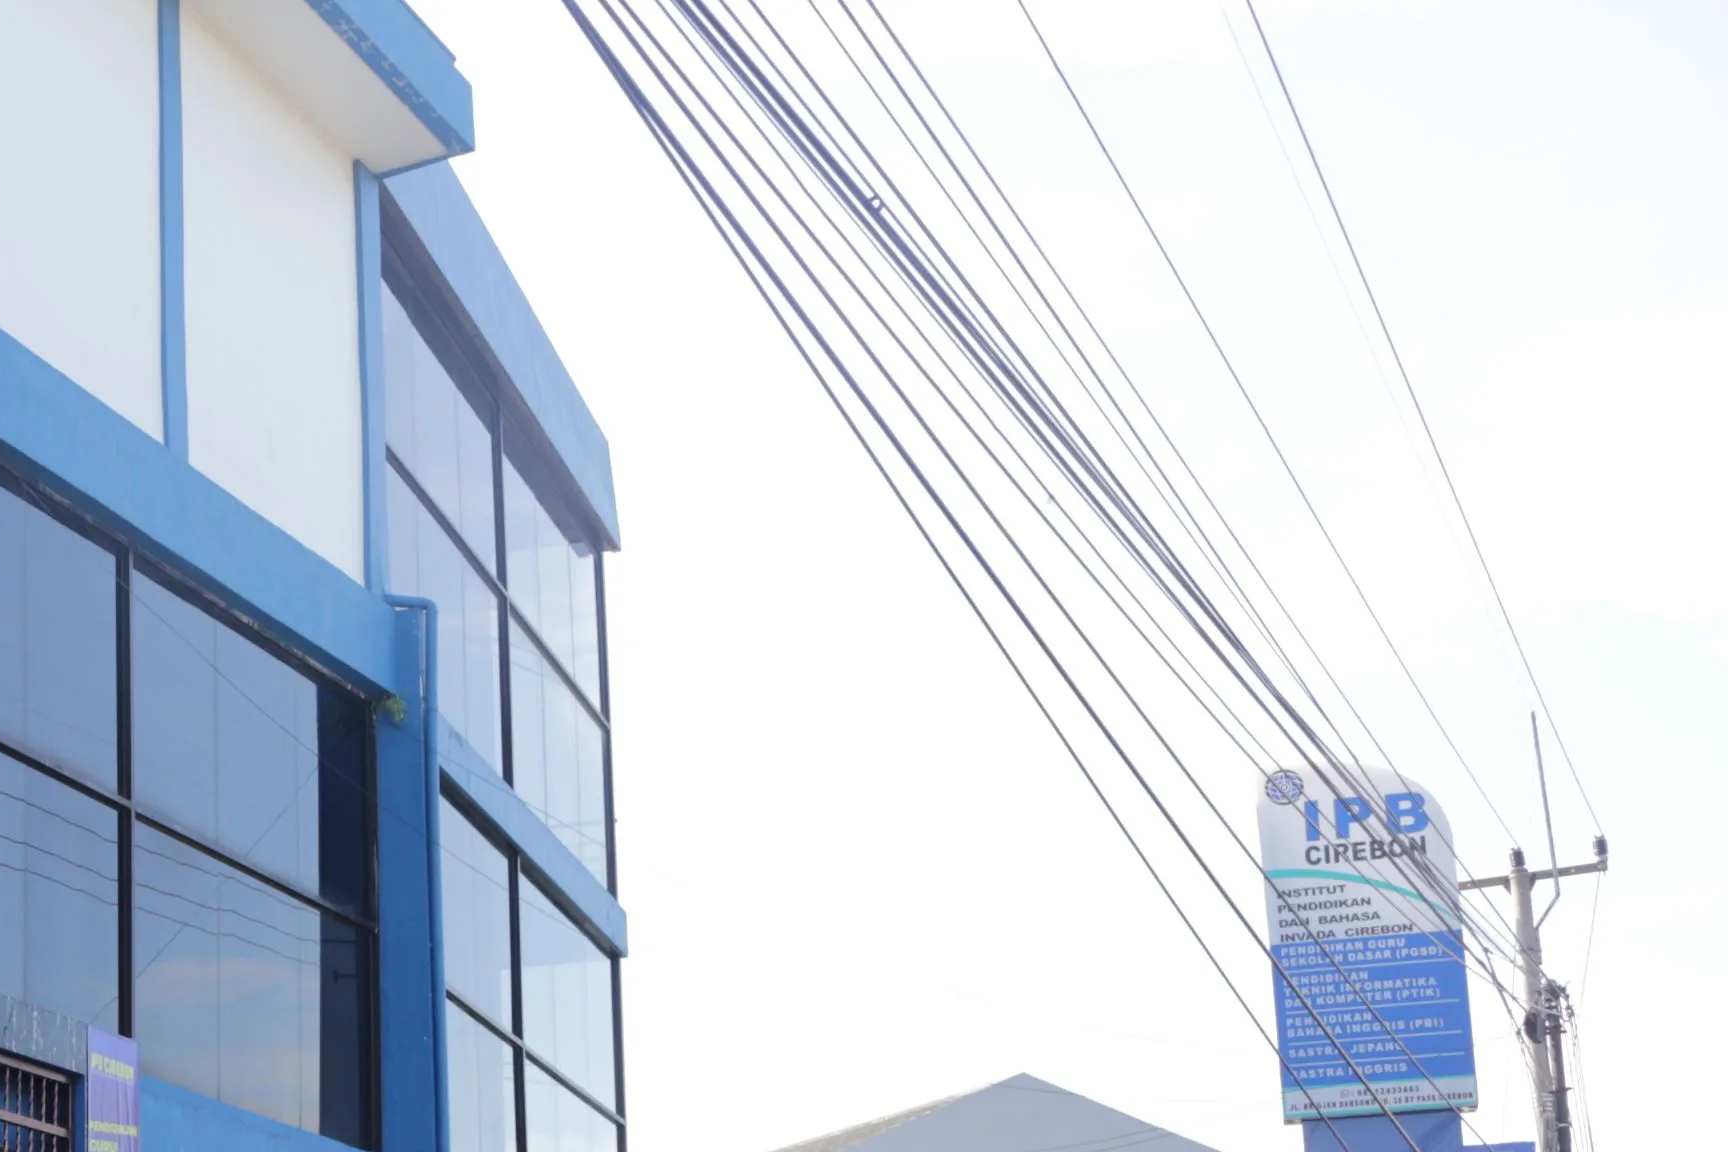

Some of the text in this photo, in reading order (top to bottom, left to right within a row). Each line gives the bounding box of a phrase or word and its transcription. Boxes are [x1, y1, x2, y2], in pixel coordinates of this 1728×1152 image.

[1304, 792, 1430, 842] IPB
[1304, 836, 1427, 866] CIREBON
[1278, 897, 1371, 913] PENDIDIKAN
[1319, 911, 1381, 925] BAHASA
[1280, 923, 1413, 943] INVADA CIREBON
[1368, 937, 1405, 948] GURU
[1348, 949, 1392, 961] DASAR
[1397, 988, 1440, 1000] (PTIK)
